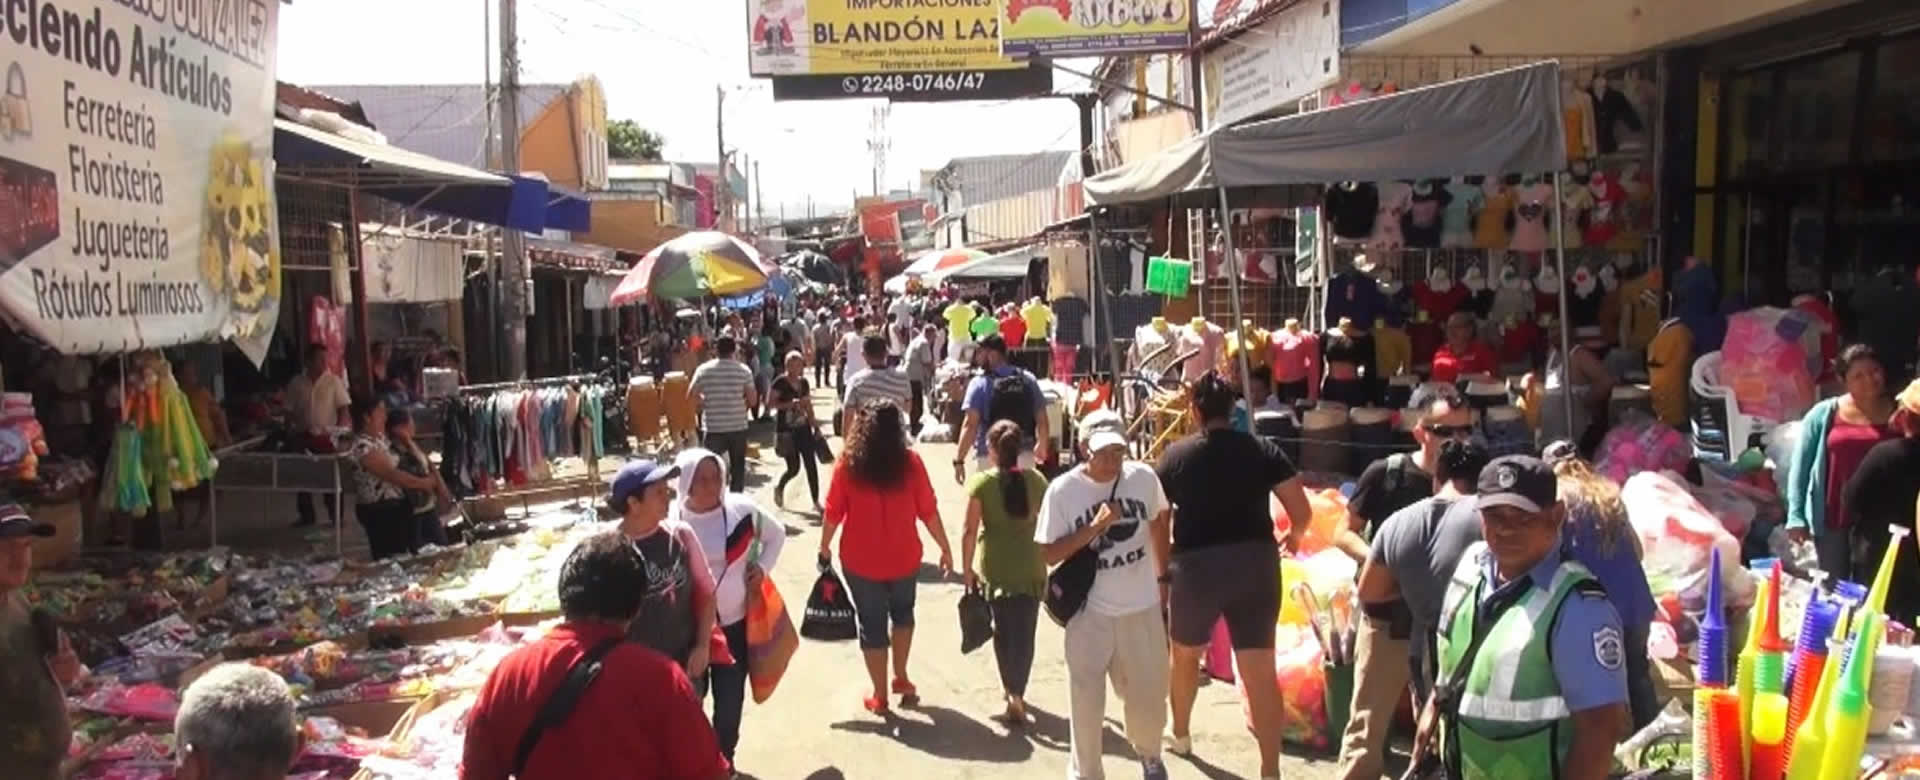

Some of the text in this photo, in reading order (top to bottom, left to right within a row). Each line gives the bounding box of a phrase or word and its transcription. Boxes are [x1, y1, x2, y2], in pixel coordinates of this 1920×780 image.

[0, 0, 232, 115] ciendo Artículos
[813, 16, 944, 44] BLANDÓN
[862, 72, 985, 93] 2248-0746/47
[63, 80, 156, 150] Ferreteria
[69, 144, 164, 205] Floristeria
[72, 207, 169, 272] Jugueteria
[31, 266, 203, 320] Rótulos Luminosos
